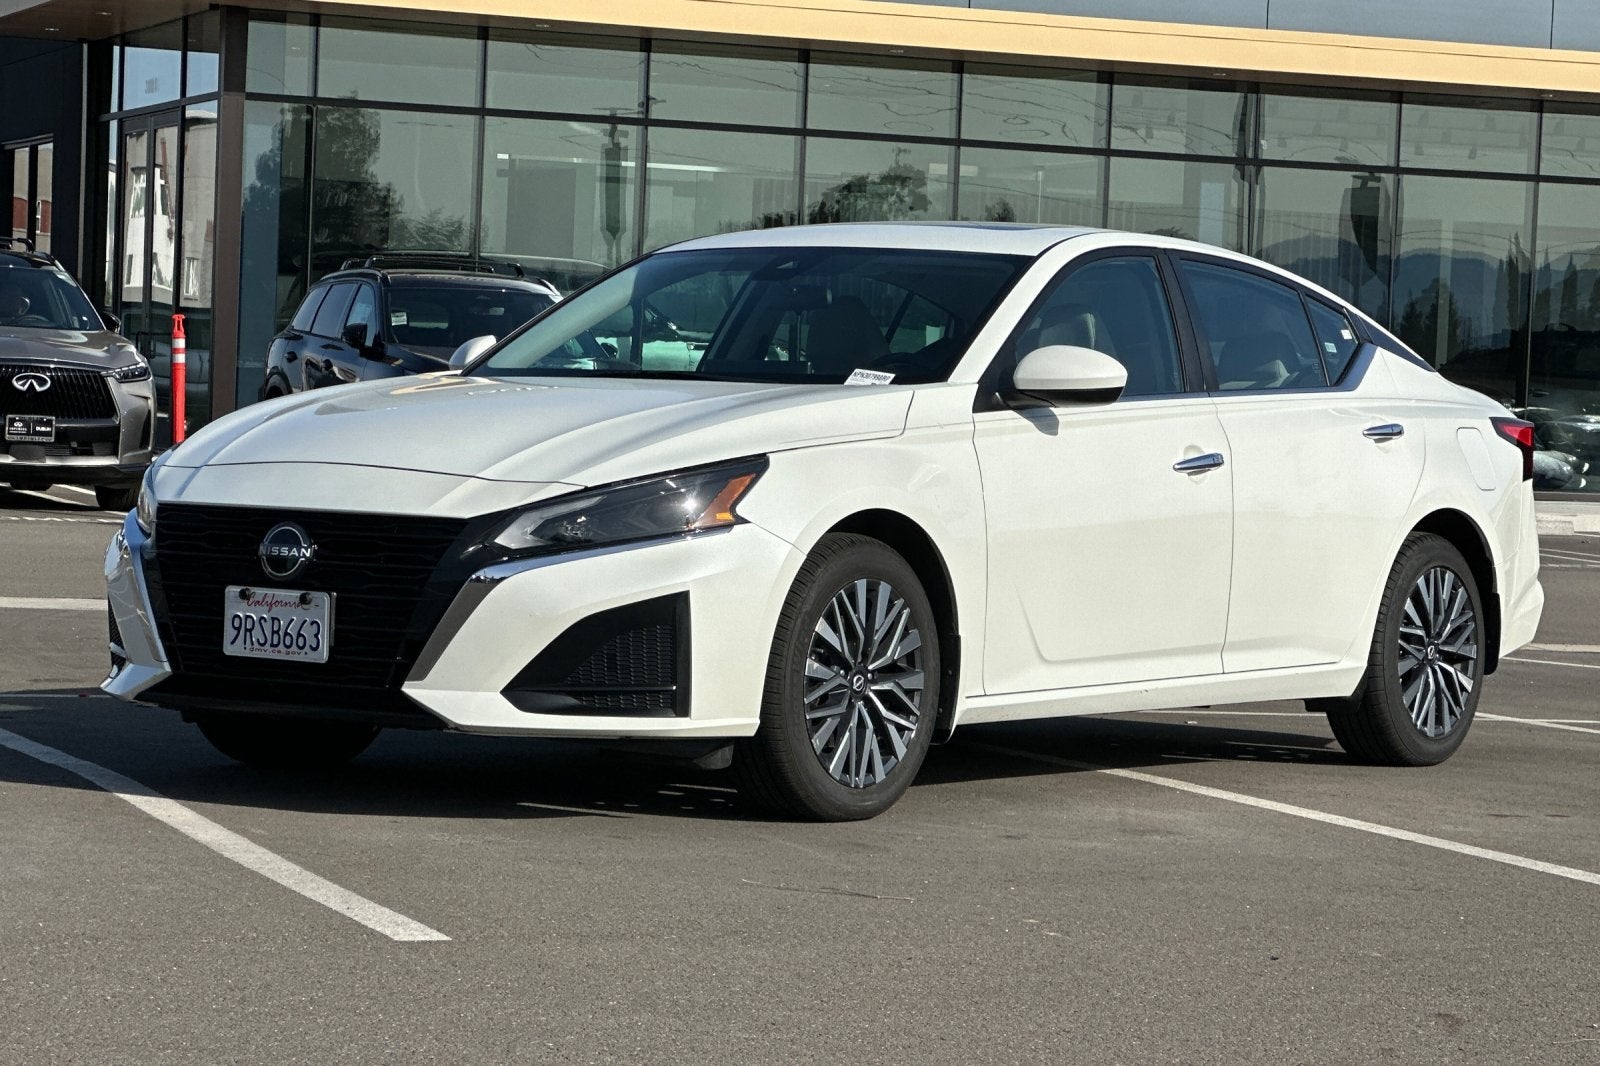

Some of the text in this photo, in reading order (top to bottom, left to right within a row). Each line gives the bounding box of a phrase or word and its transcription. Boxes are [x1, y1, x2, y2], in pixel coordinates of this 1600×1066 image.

[260, 546, 311, 557] NISSAN
[230, 612, 322, 652] 9RSB663
[248, 646, 302, 656] dmv.ca.gov
